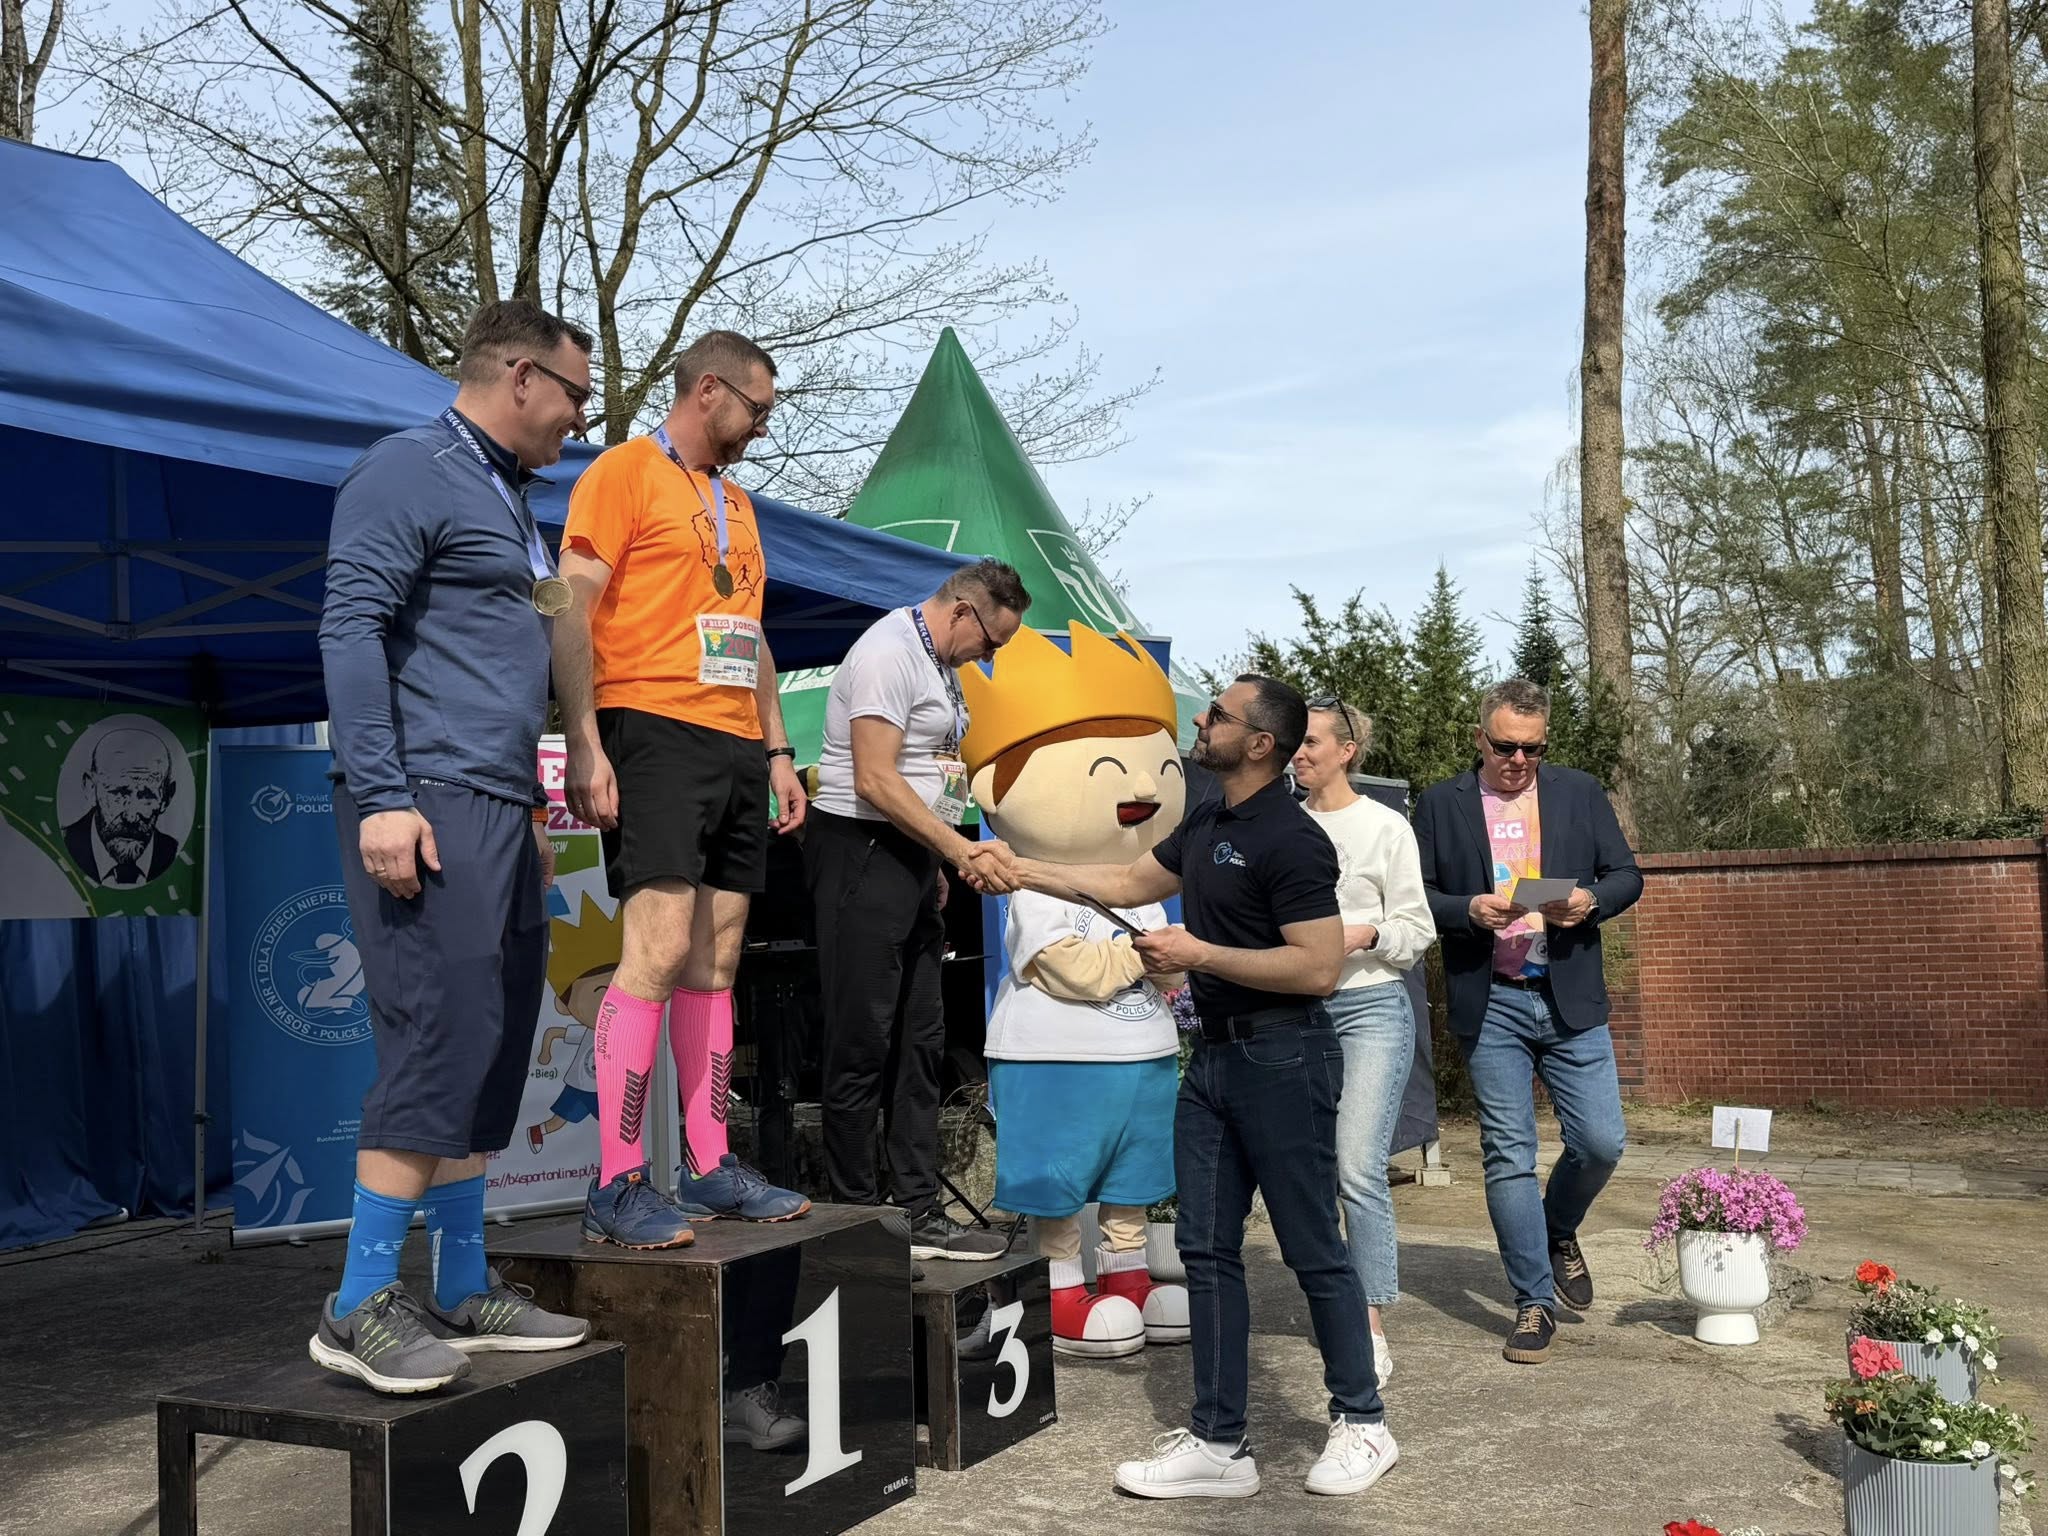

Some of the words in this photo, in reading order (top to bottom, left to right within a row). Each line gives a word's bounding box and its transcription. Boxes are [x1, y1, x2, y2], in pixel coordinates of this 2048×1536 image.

[296, 793, 329, 802] Powiat
[263, 906, 298, 945] DZIECI
[257, 946, 271, 973] DLA
[262, 986, 280, 1006] NR
[1115, 1004, 1148, 1015] POLICE
[273, 1006, 311, 1035] SOSW
[319, 1027, 360, 1039] POLICE
[987, 1300, 1030, 1418] 3
[781, 1284, 863, 1497] 1
[458, 1419, 568, 1536] 2
